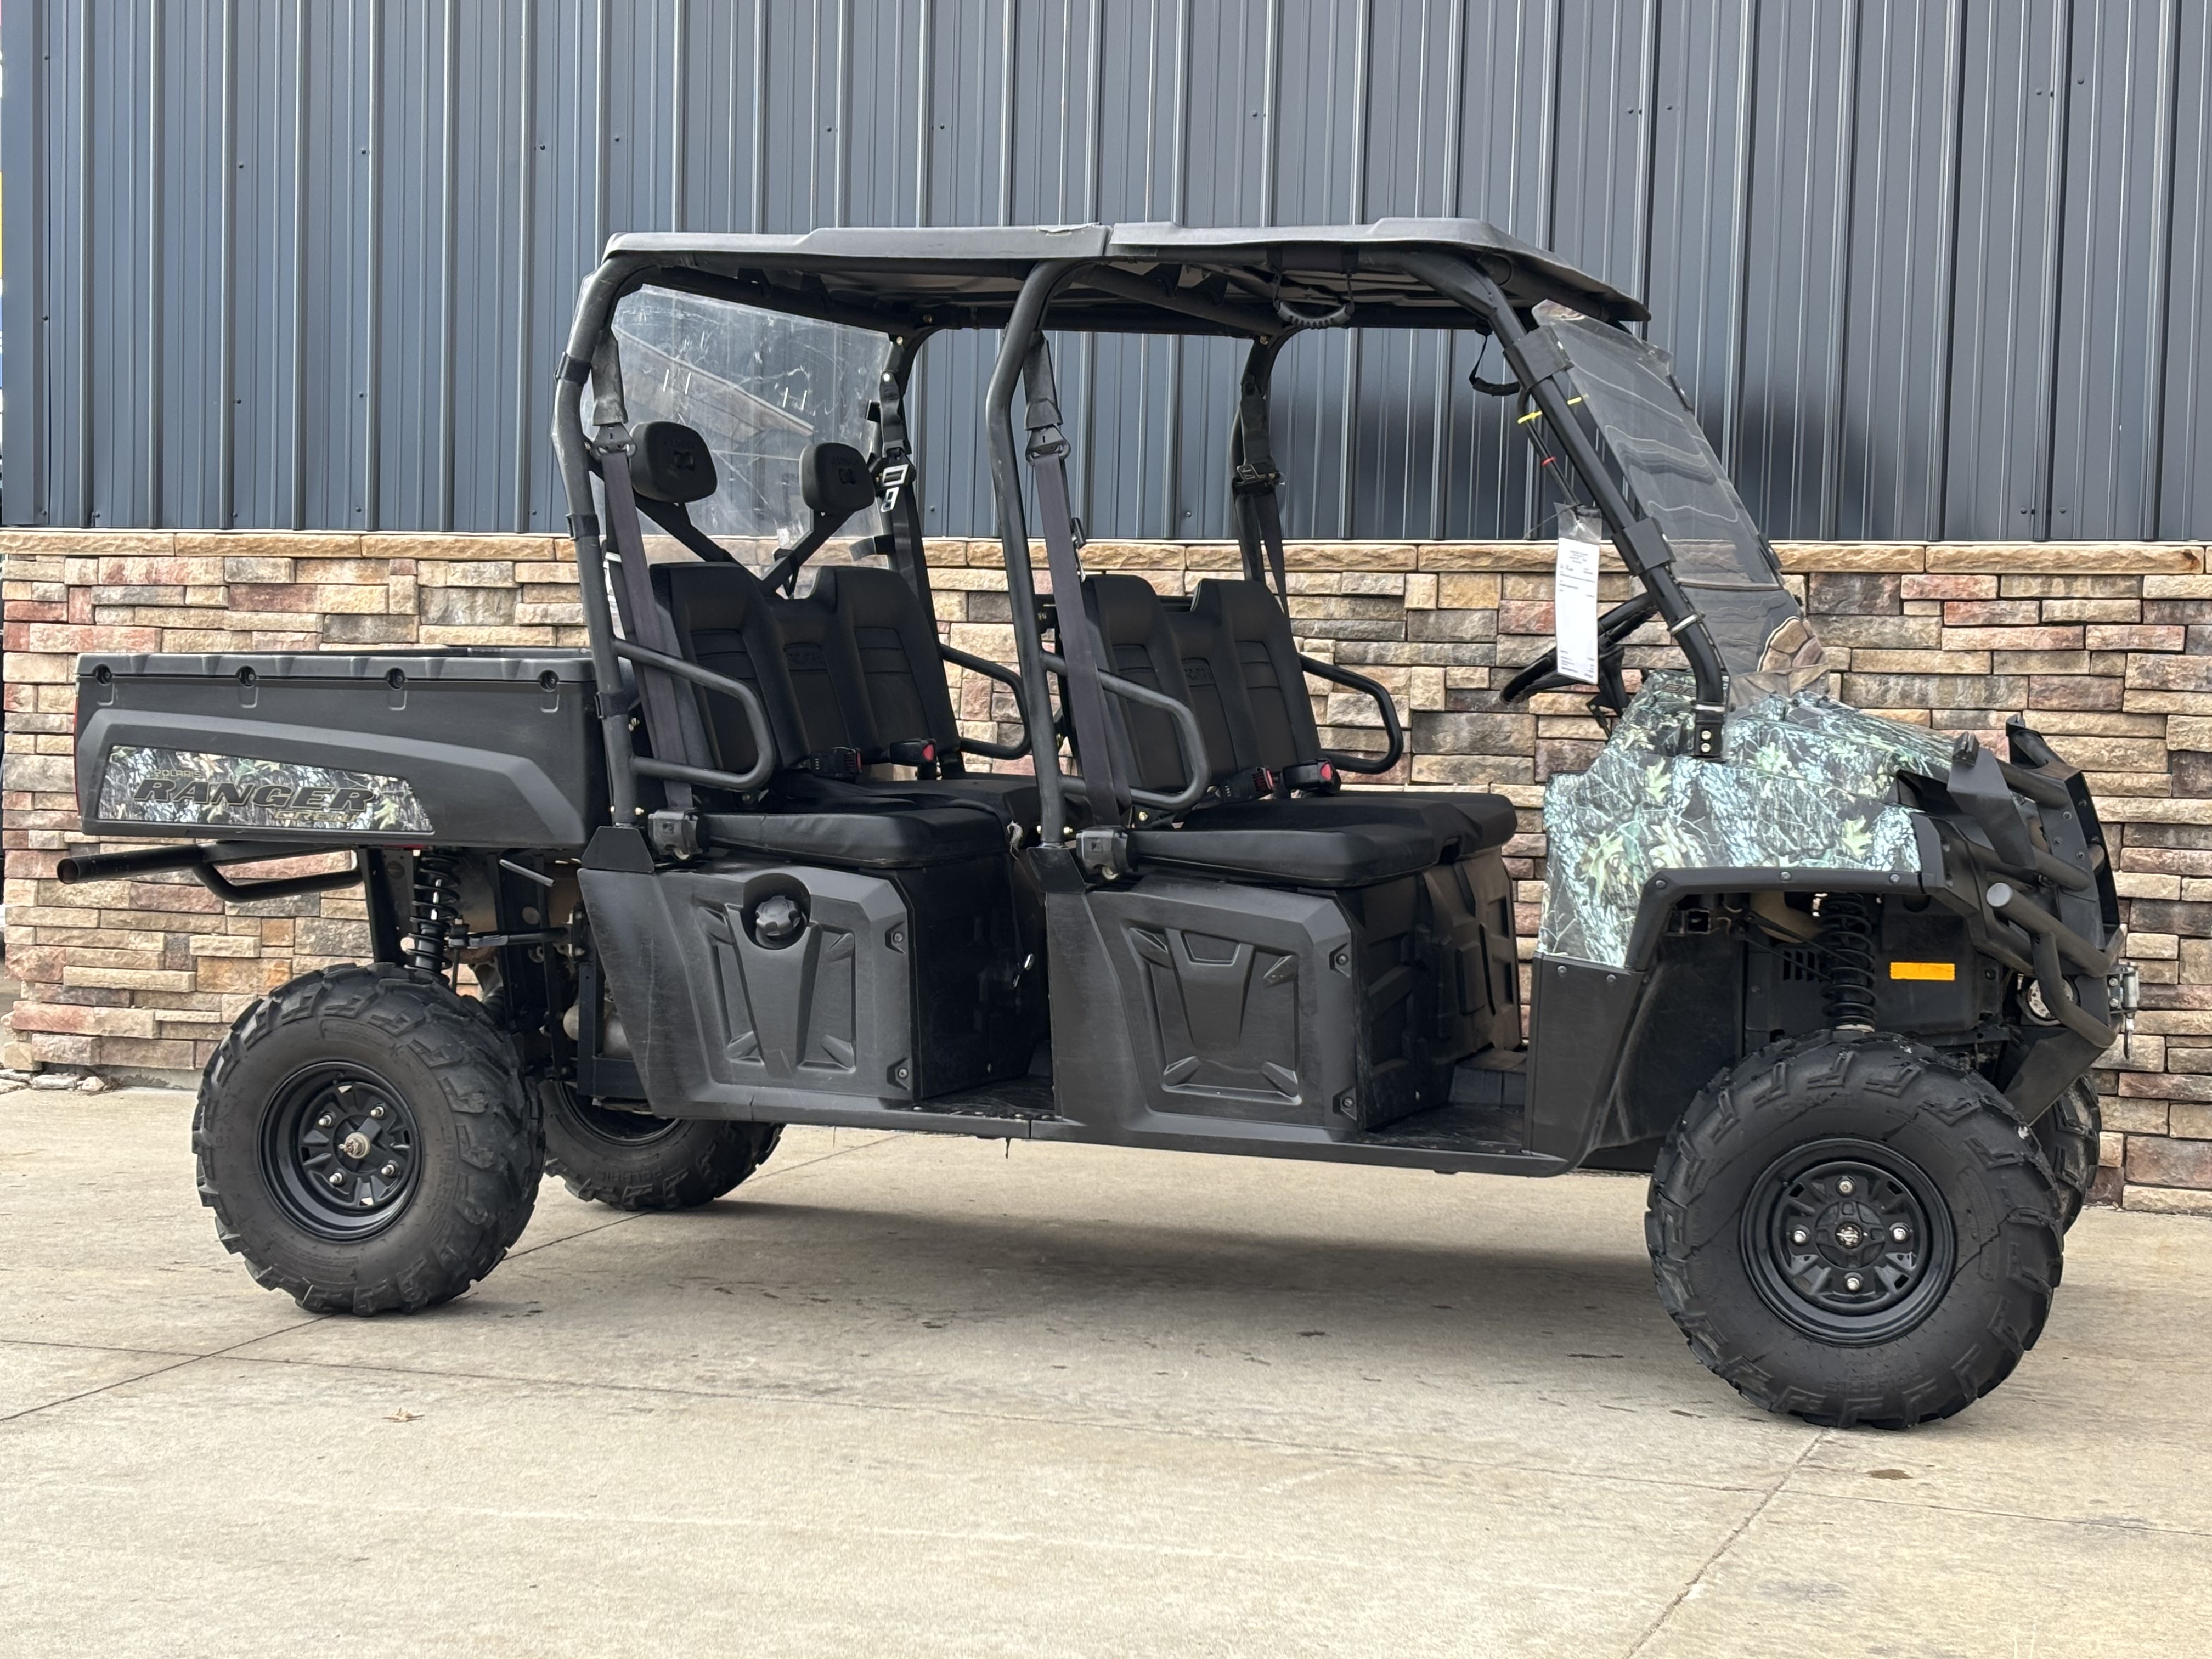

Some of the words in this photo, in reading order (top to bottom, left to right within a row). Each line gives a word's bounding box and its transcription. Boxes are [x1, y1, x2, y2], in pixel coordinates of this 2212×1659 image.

[154, 769, 202, 778] POLARIS
[134, 778, 375, 813] RANGER
[275, 810, 359, 823] CREW
